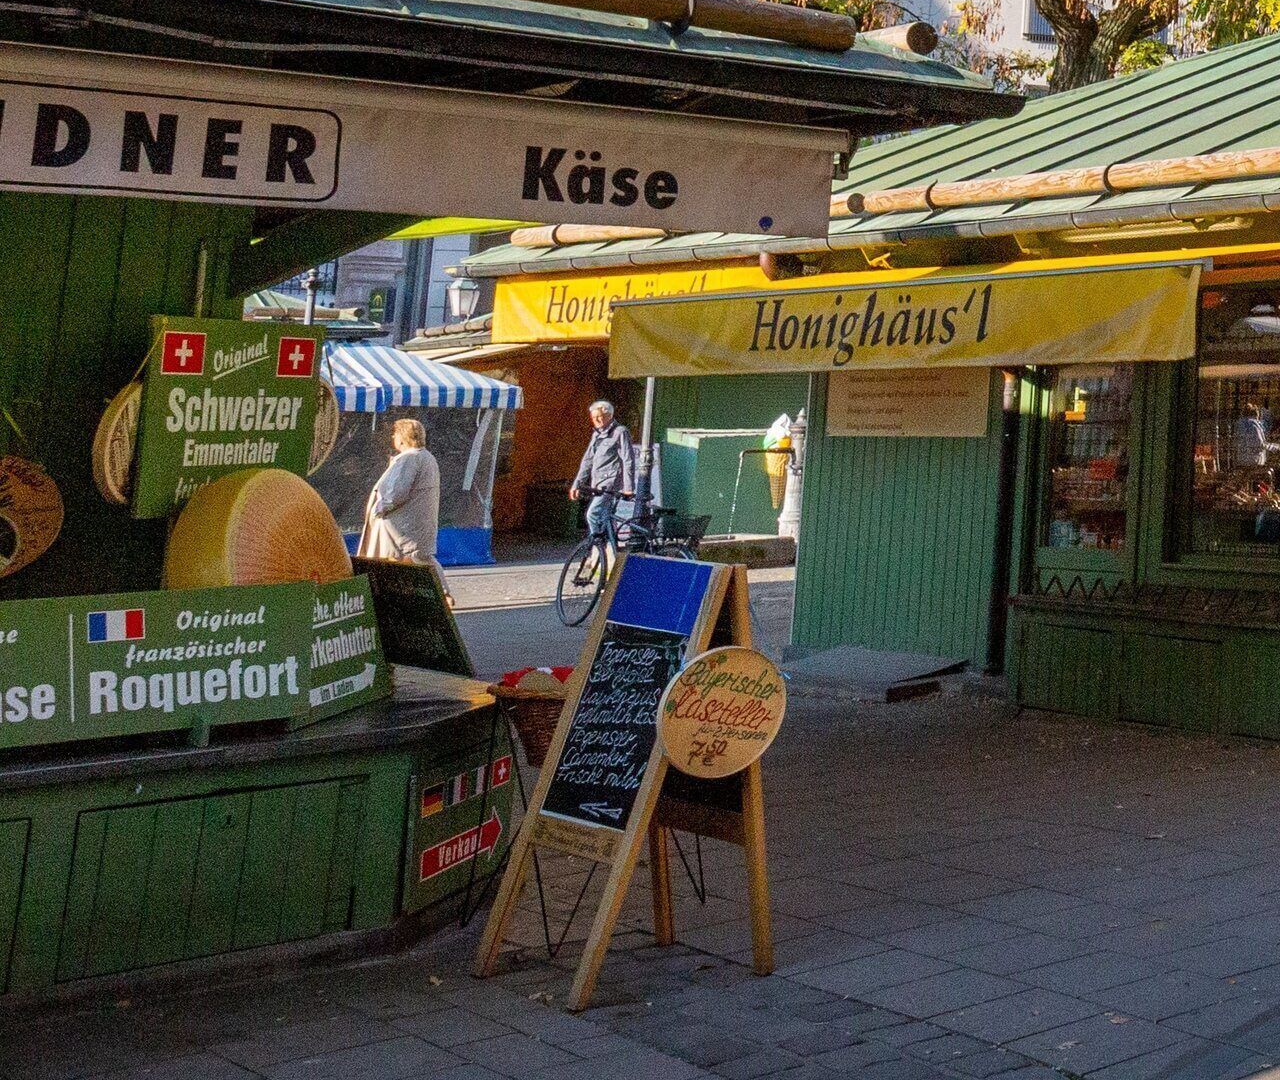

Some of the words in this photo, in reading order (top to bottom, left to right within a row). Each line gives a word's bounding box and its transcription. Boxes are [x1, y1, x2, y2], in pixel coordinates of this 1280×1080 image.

[0, 99, 318, 185] DNER
[521, 145, 679, 210] Käse
[748, 283, 993, 367] Honighäus'l
[213, 333, 270, 373] Original
[166, 387, 303, 433] Schweizer
[182, 437, 280, 467] Emmentaler
[176, 605, 266, 632] Original
[125, 635, 267, 670] französischer
[310, 626, 377, 669] rkenbutter
[0, 683, 56, 723] se
[89, 655, 300, 716] Roquefort
[438, 832, 483, 869] Verkau
